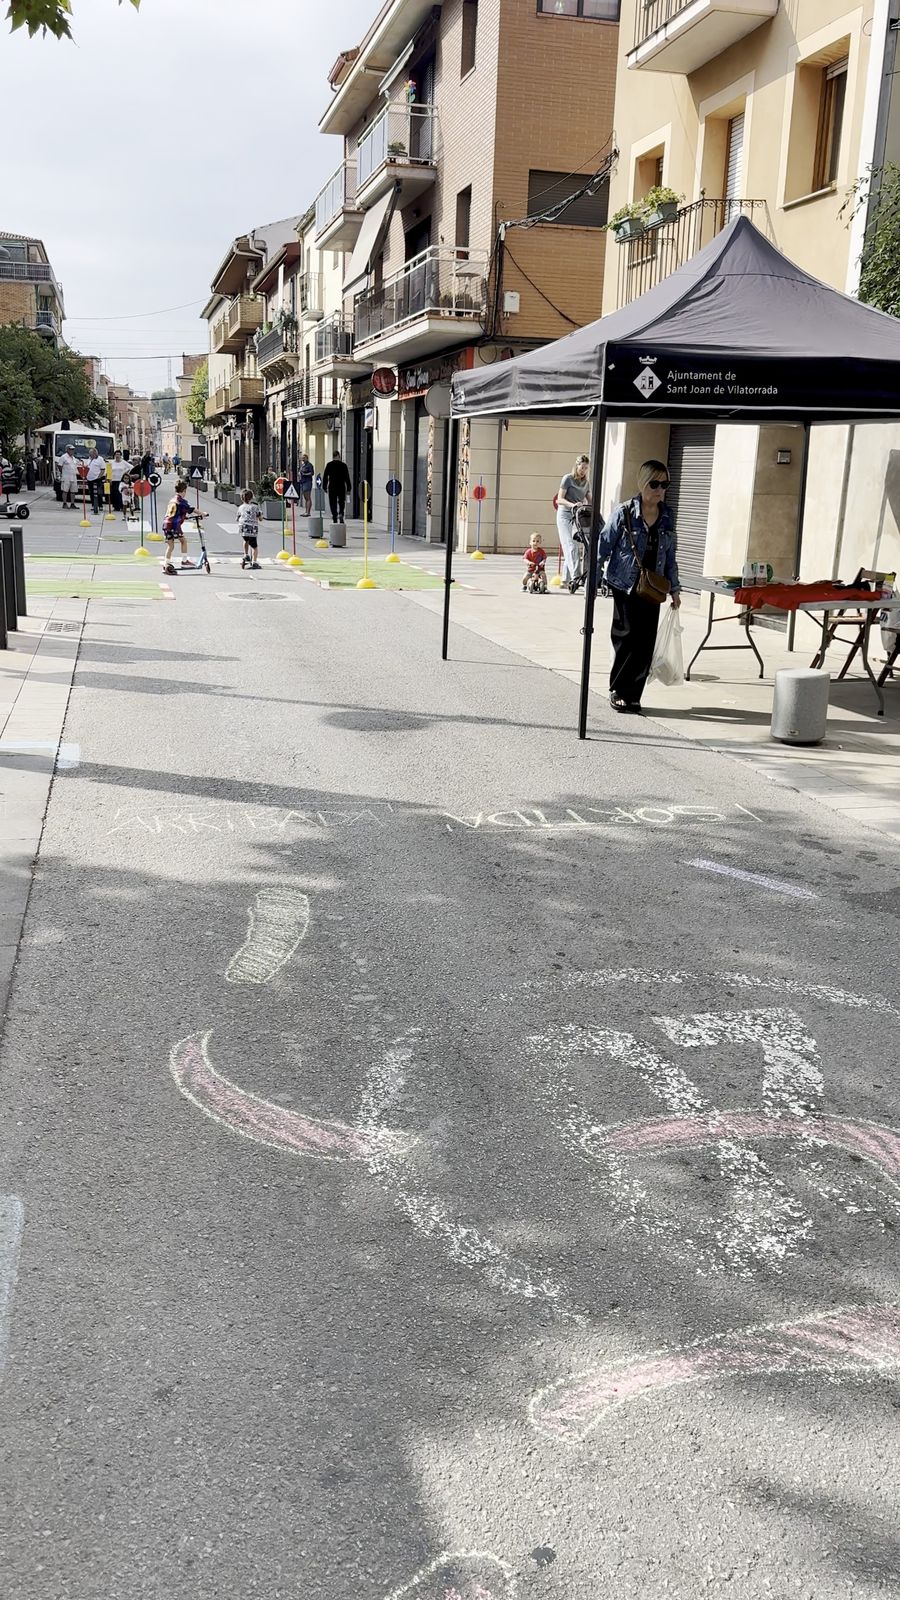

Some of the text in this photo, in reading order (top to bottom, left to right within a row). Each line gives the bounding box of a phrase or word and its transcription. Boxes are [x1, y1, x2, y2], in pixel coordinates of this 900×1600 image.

[667, 370, 737, 382] Ajuntament de
[667, 384, 778, 395] Sant Joan de Vilatorrada
